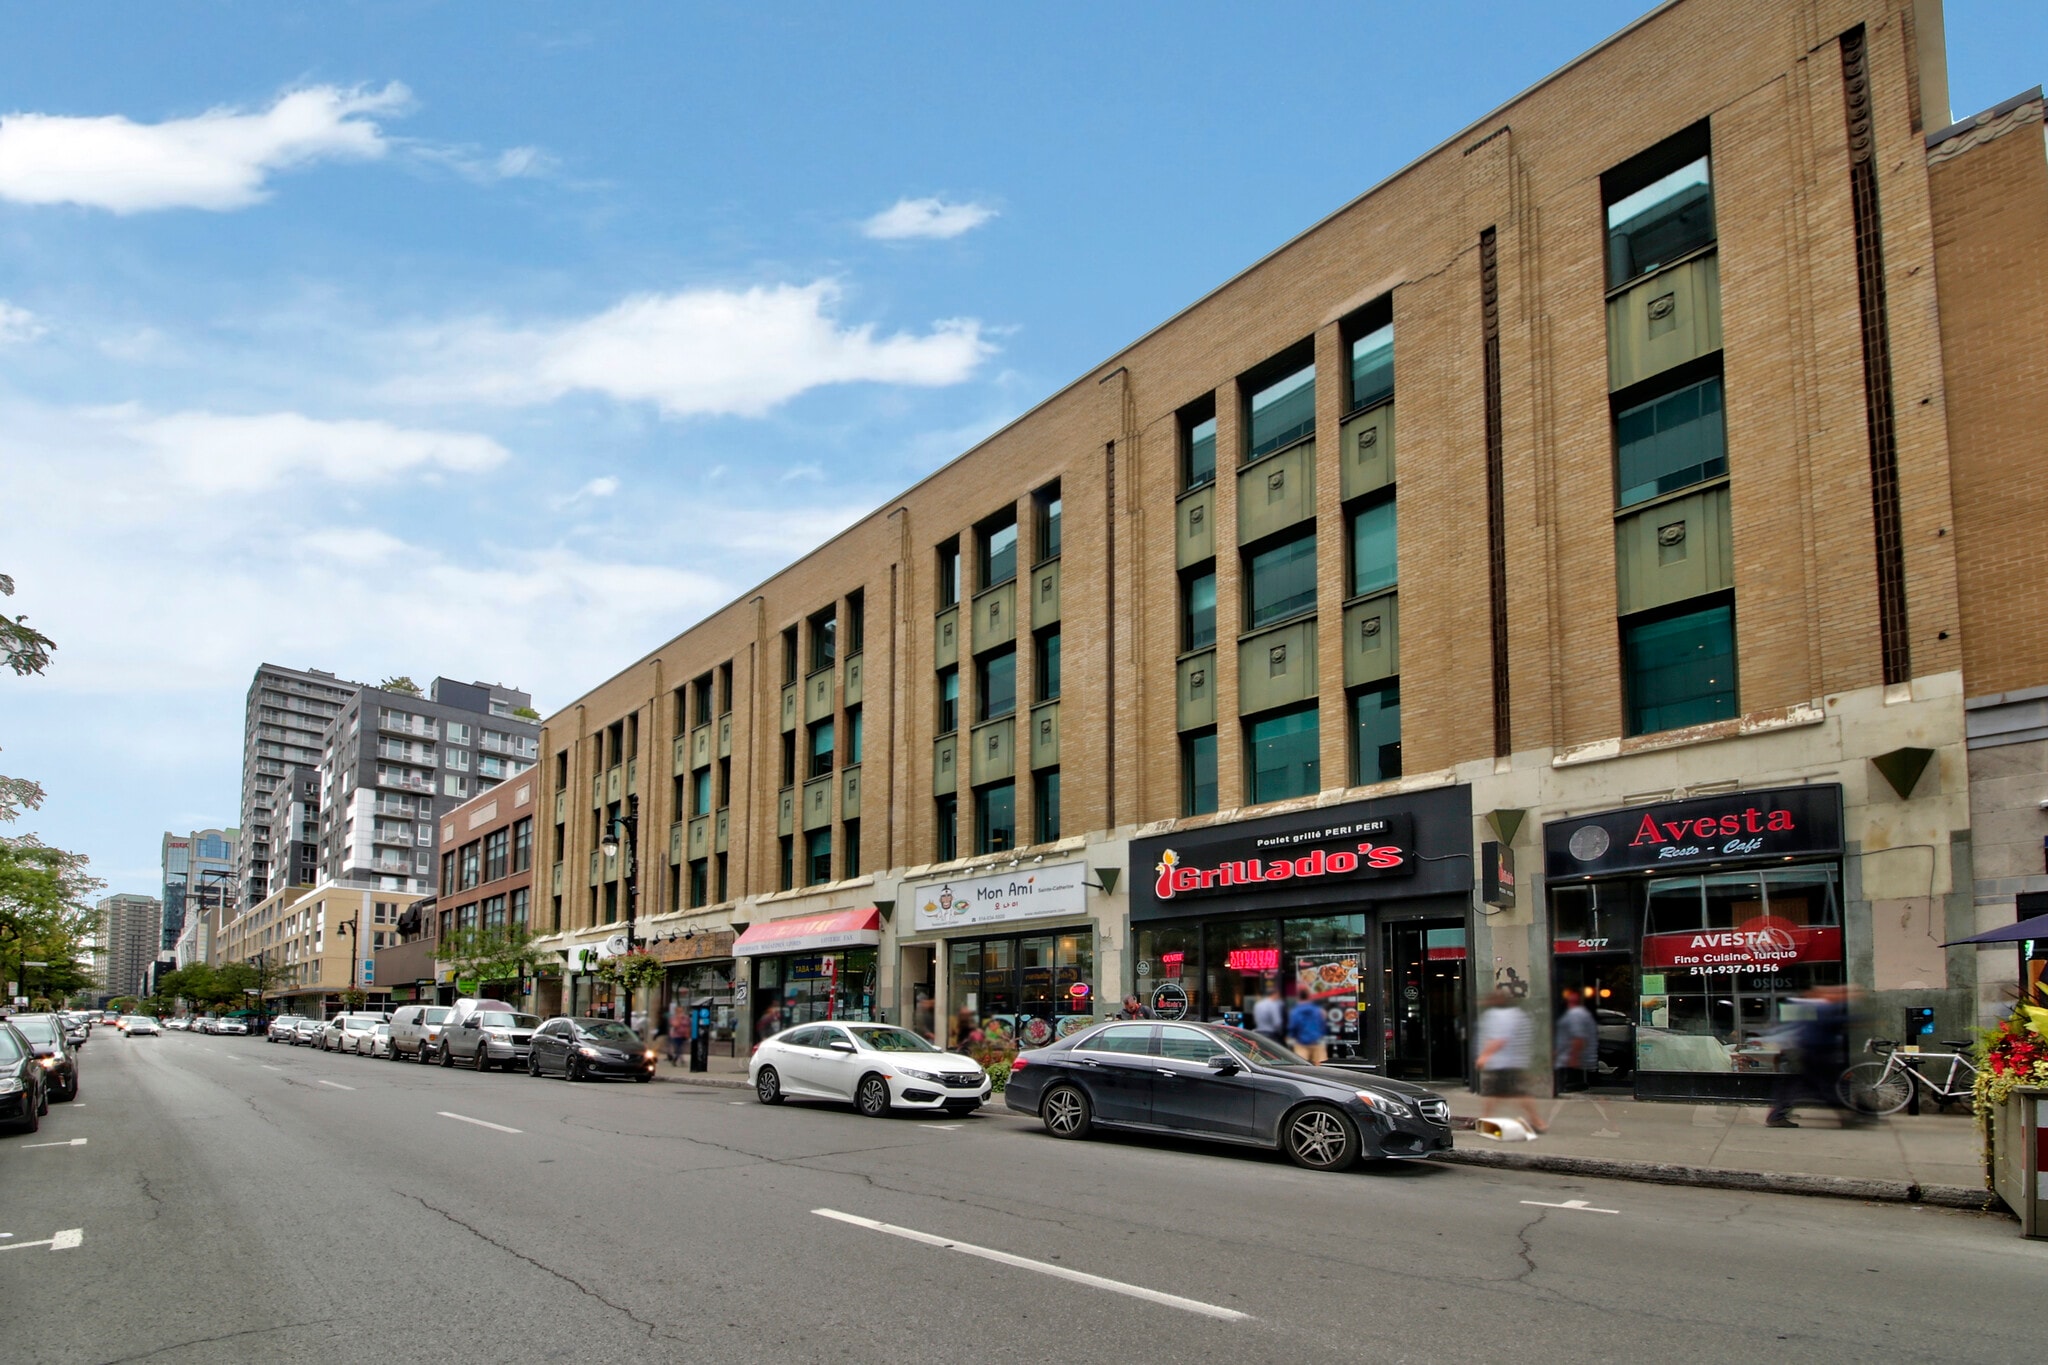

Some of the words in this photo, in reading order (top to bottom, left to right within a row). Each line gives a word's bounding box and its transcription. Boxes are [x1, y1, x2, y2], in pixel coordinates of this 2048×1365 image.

[1257, 835, 1290, 847] Poulet
[1292, 830, 1322, 843] grillé
[1325, 825, 1352, 837] PERI
[1355, 820, 1384, 832] PERI
[1628, 807, 1795, 847] Avesta
[1658, 845, 1700, 859] Resto
[1722, 837, 1764, 854] Café
[1171, 843, 1404, 892] Grillado's
[977, 887, 1003, 901] Mon
[1008, 878, 1033, 897] Ami
[1578, 938, 1609, 948] 2077
[1691, 930, 1773, 949] AVESTA
[1674, 954, 1700, 965] Fine
[1703, 952, 1751, 963] Cuisine
[1753, 949, 1798, 960] Turque
[1690, 963, 1779, 976] 514-937-0156
